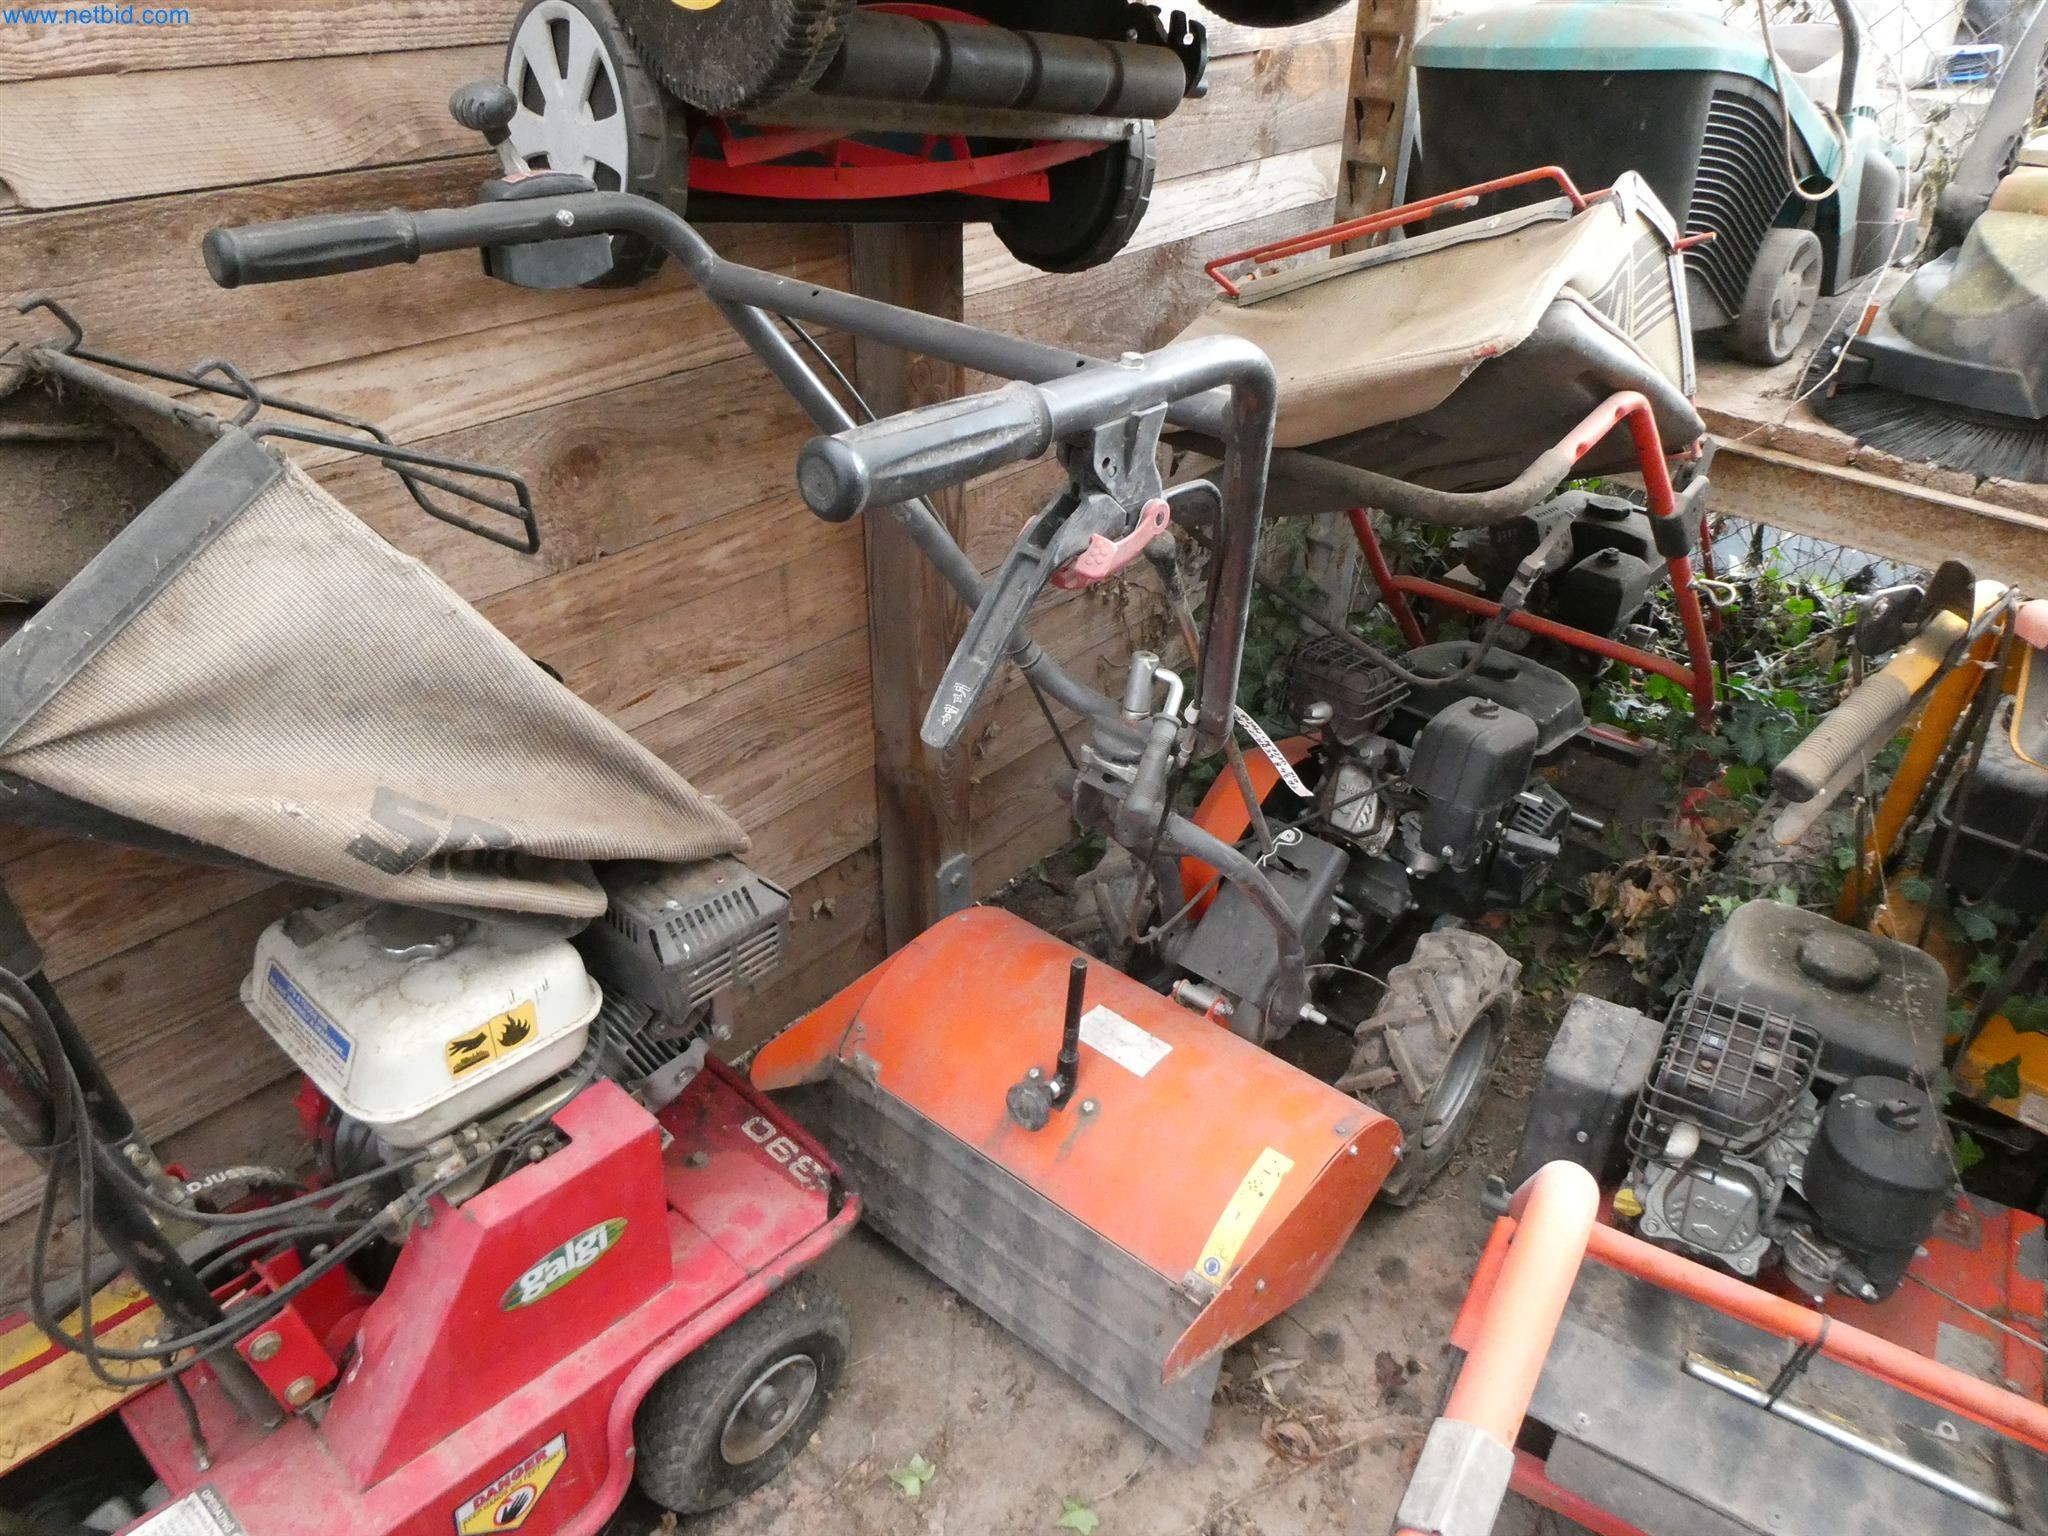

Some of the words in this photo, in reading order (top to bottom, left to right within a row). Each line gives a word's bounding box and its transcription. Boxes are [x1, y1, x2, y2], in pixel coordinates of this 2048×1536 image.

[741, 1116, 824, 1184] 390
[520, 1225, 608, 1302] galgi
[473, 1449, 547, 1510] DANGER
